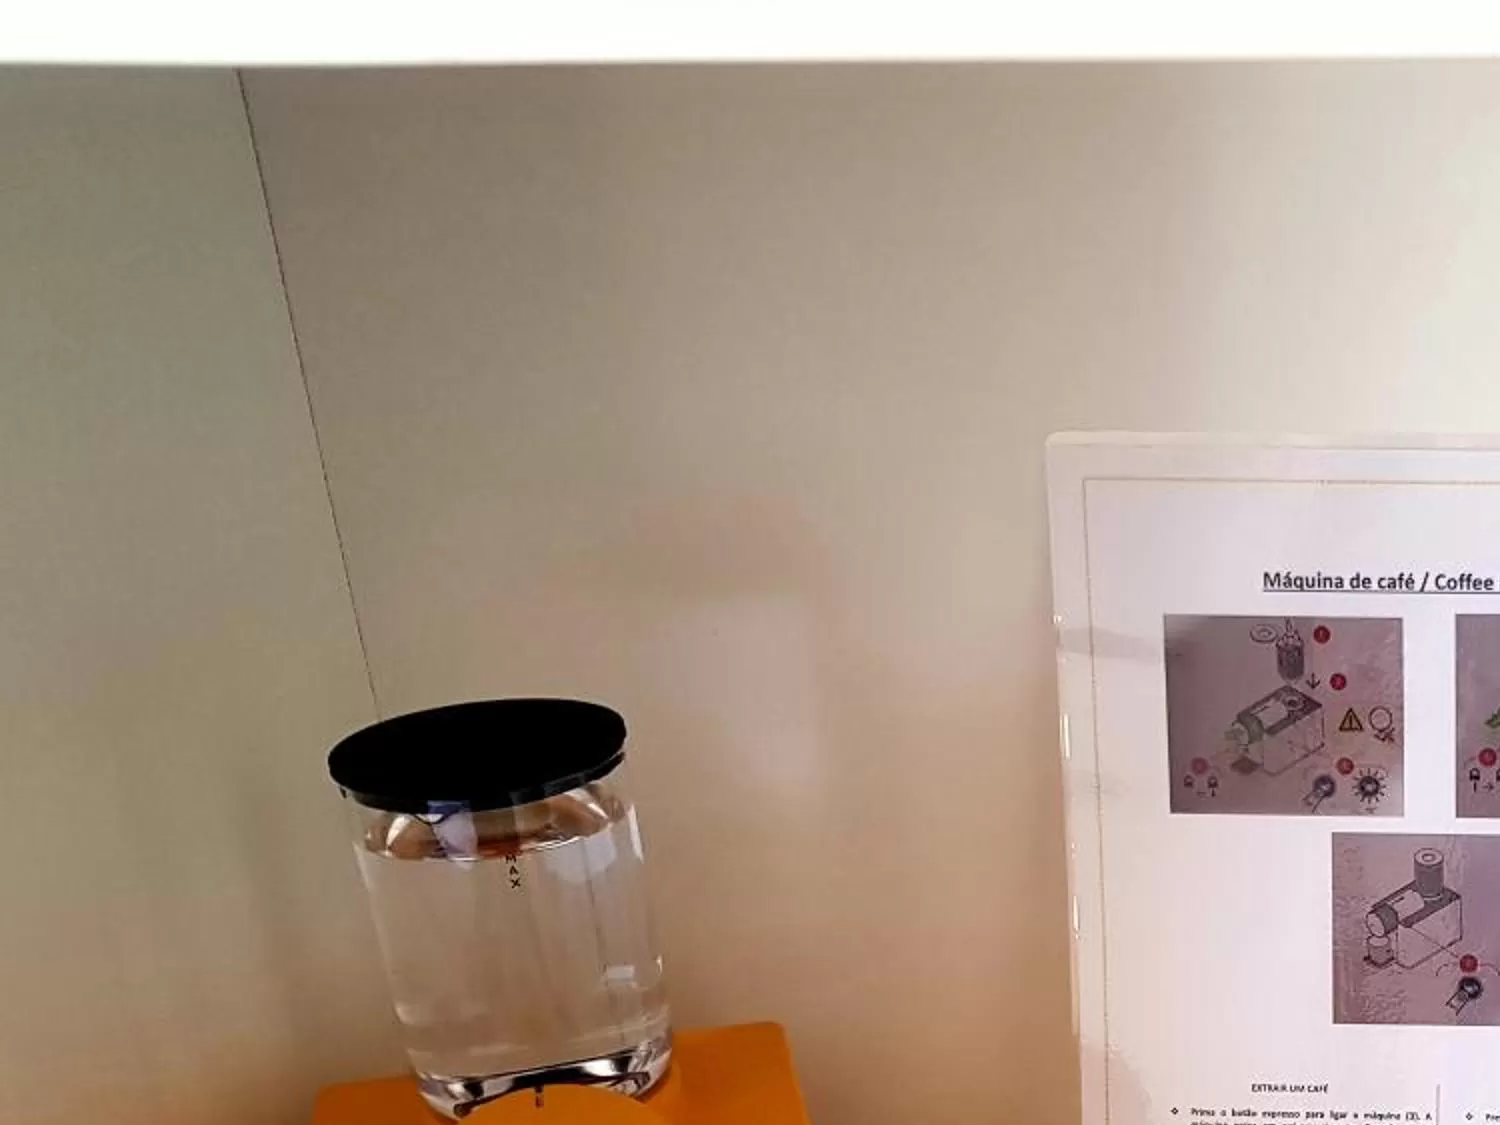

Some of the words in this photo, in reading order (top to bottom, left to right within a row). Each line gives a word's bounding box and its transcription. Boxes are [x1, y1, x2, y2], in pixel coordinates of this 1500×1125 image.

[1263, 571, 1345, 592] Máquina
[1350, 572, 1372, 589] de
[1377, 571, 1416, 590] café
[1419, 571, 1430, 592] /
[1434, 573, 1494, 591] Coffee
